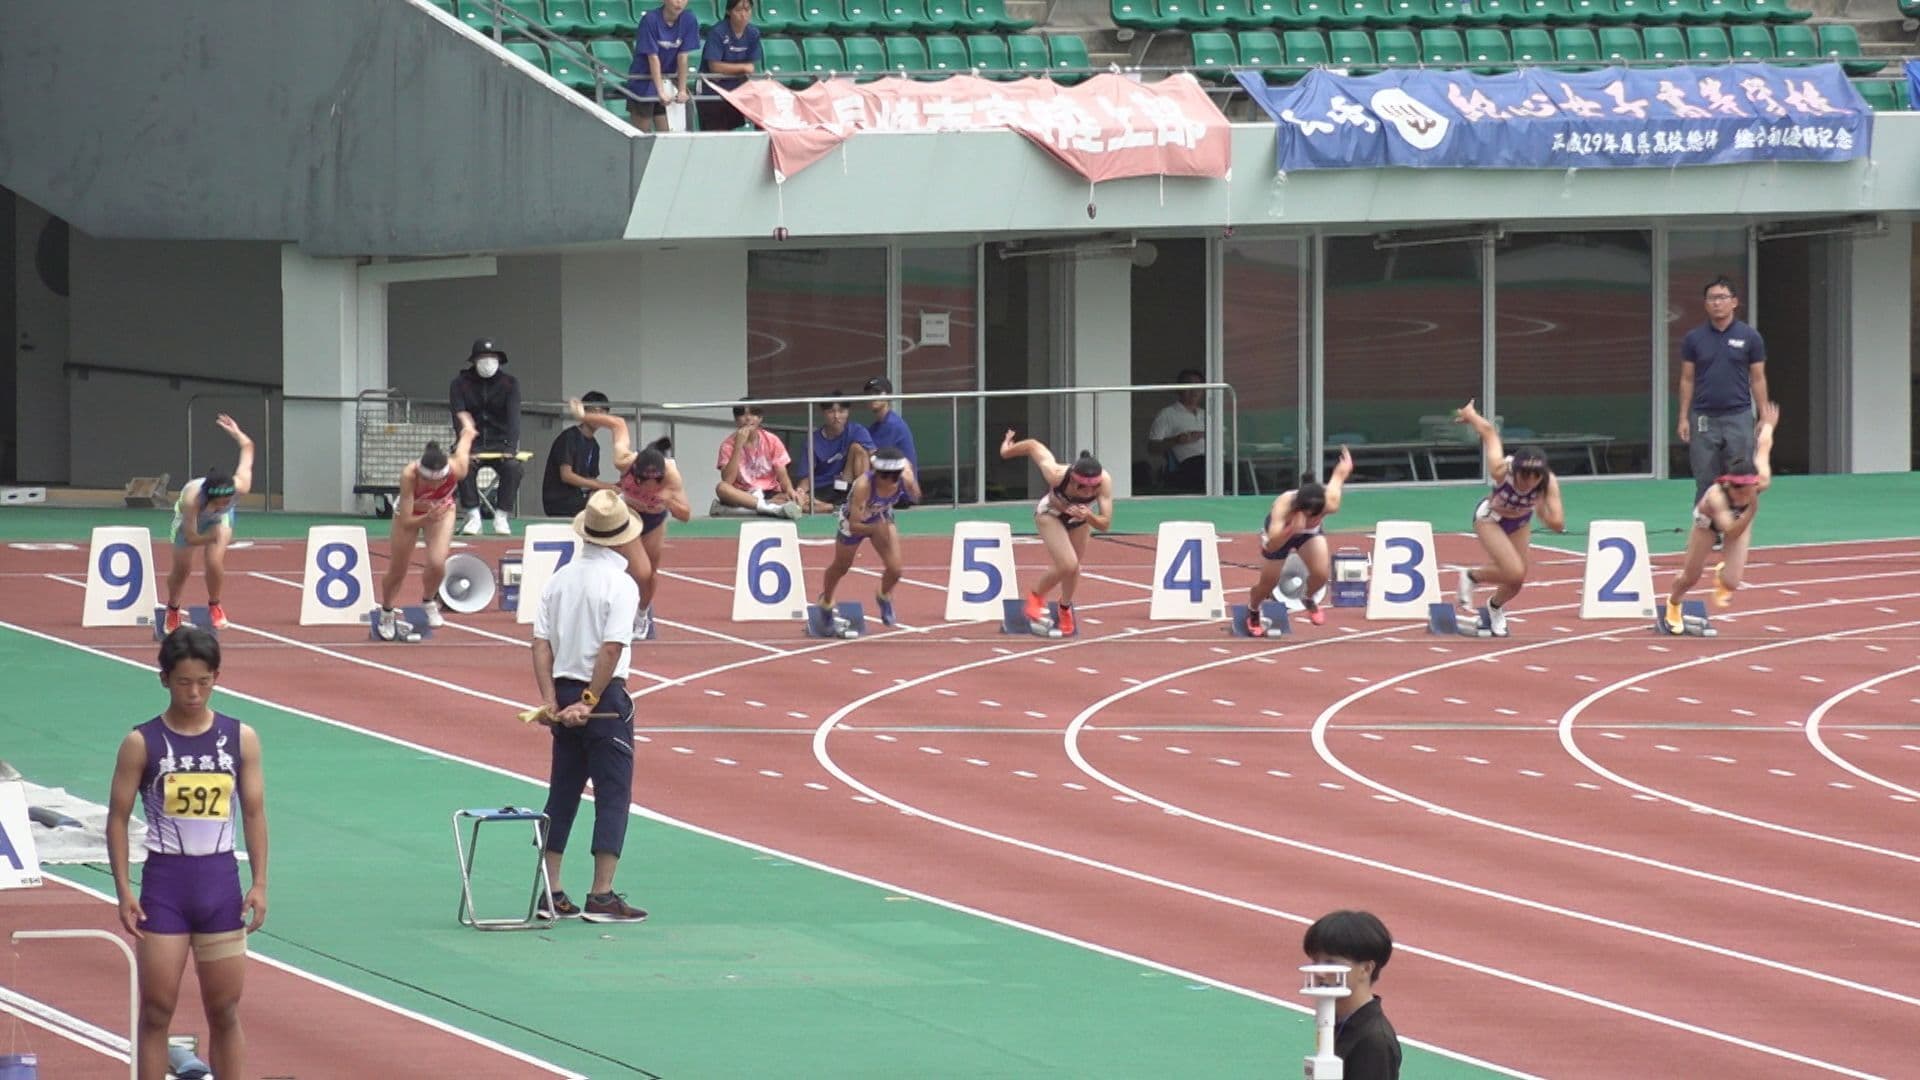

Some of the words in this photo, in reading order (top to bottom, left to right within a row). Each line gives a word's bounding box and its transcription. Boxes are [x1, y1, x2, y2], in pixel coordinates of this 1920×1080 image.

[99, 543, 143, 610] 9
[316, 542, 361, 609] 8
[533, 541, 574, 574] 7
[747, 538, 791, 604] 6
[962, 539, 1002, 603] 5
[1163, 539, 1211, 602] 4
[1385, 537, 1426, 603] 3
[1597, 538, 1639, 602] 2
[176, 786, 222, 816] 592
